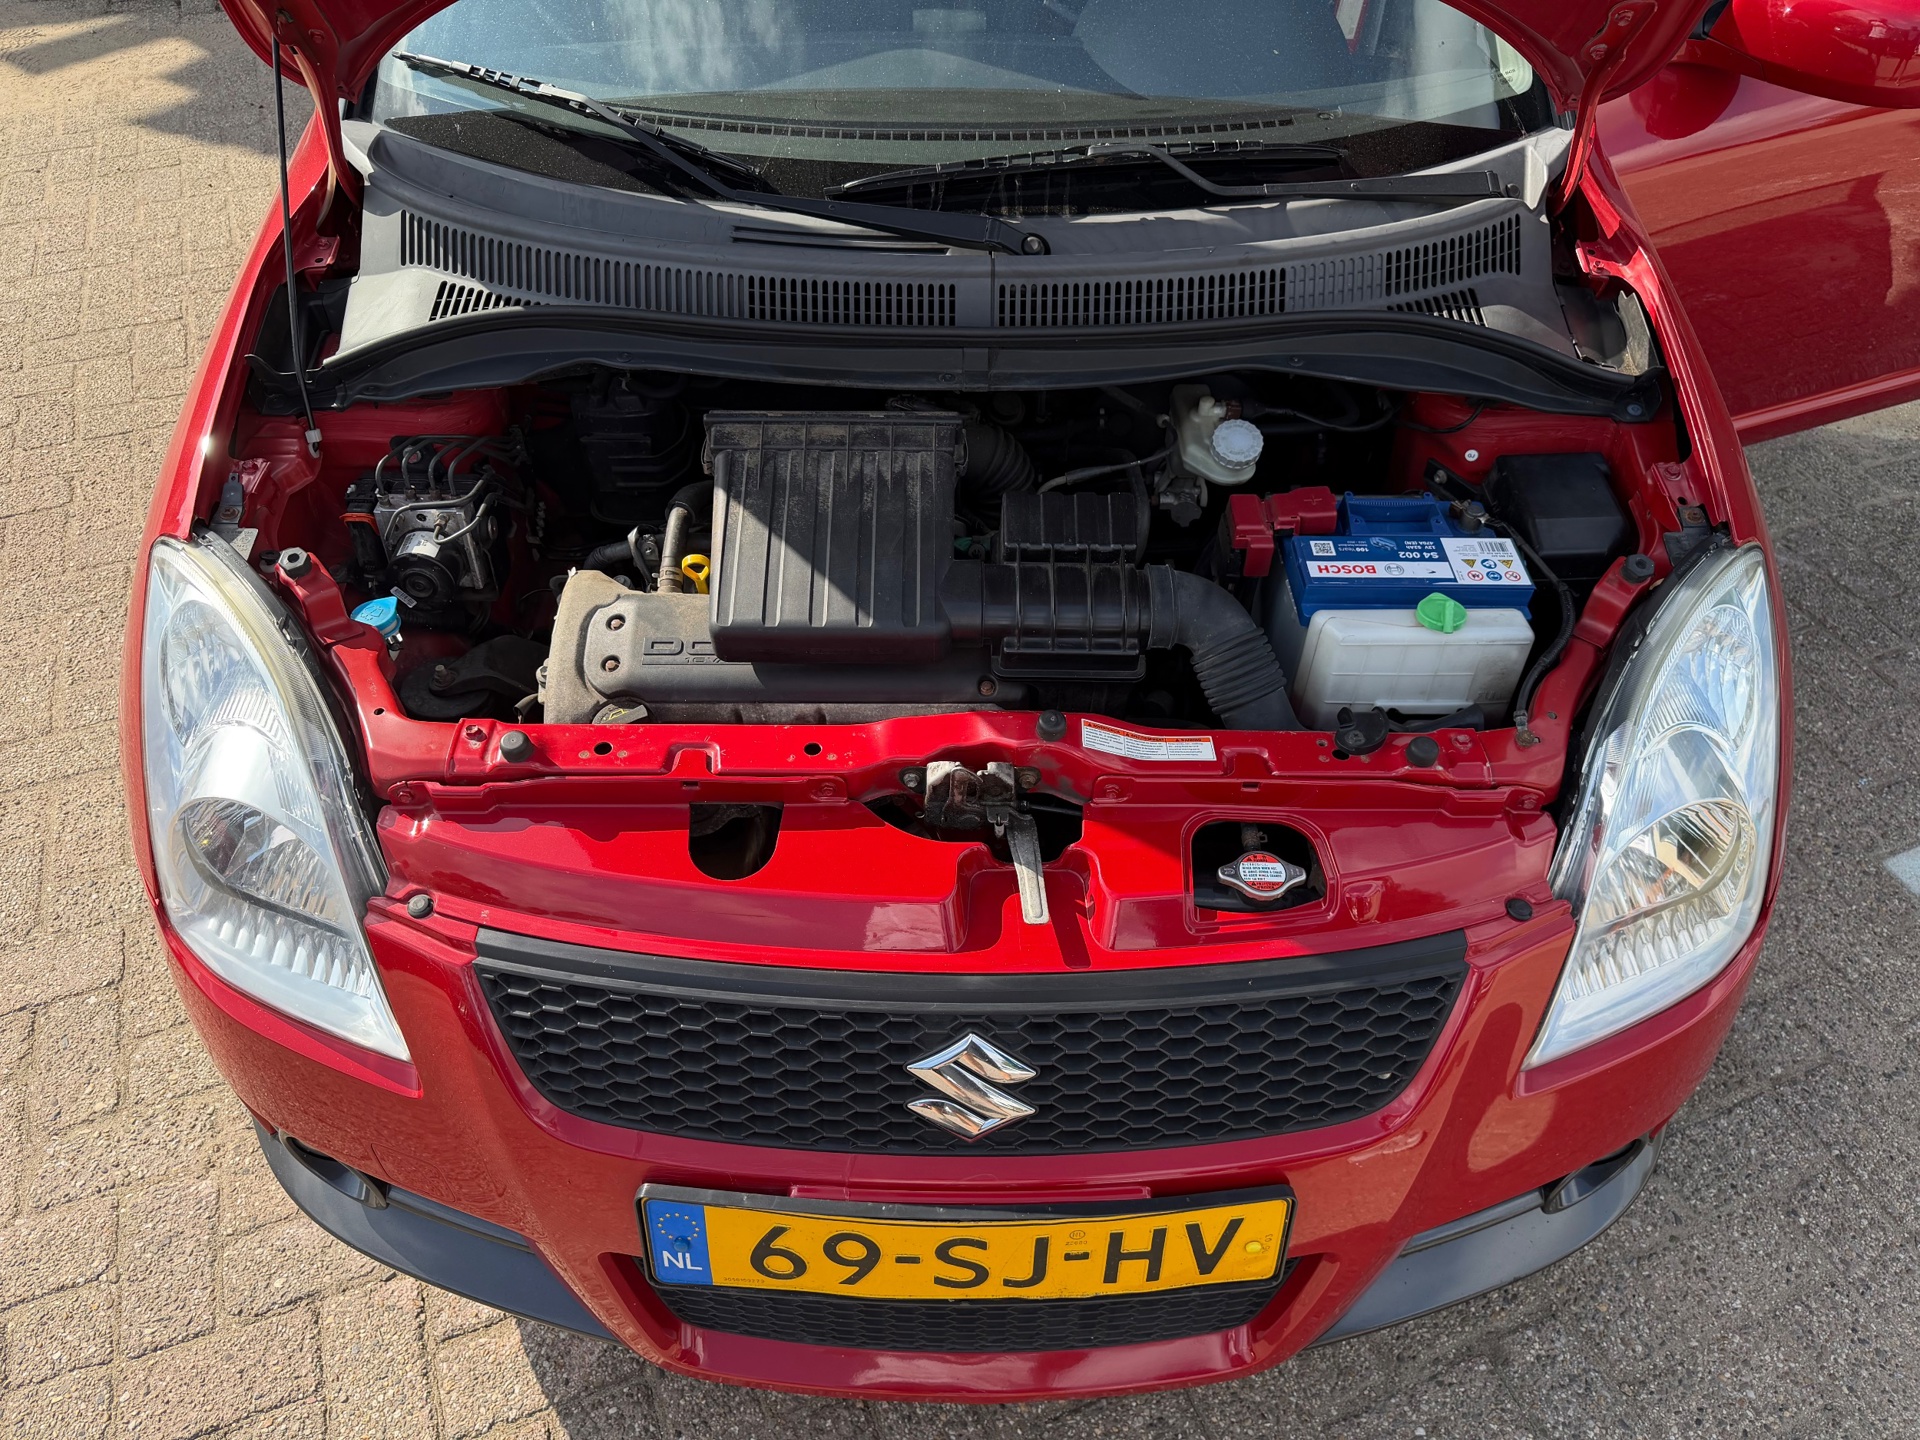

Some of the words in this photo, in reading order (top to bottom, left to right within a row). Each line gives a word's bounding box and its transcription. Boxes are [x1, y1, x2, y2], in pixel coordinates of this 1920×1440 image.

[1398, 551, 1421, 559] 002
[1423, 551, 1439, 559] S4
[1317, 564, 1377, 575] BOSCH
[643, 637, 716, 656] DO
[662, 1250, 703, 1271] NL
[750, 1217, 1245, 1289] 69-SJ-HV
